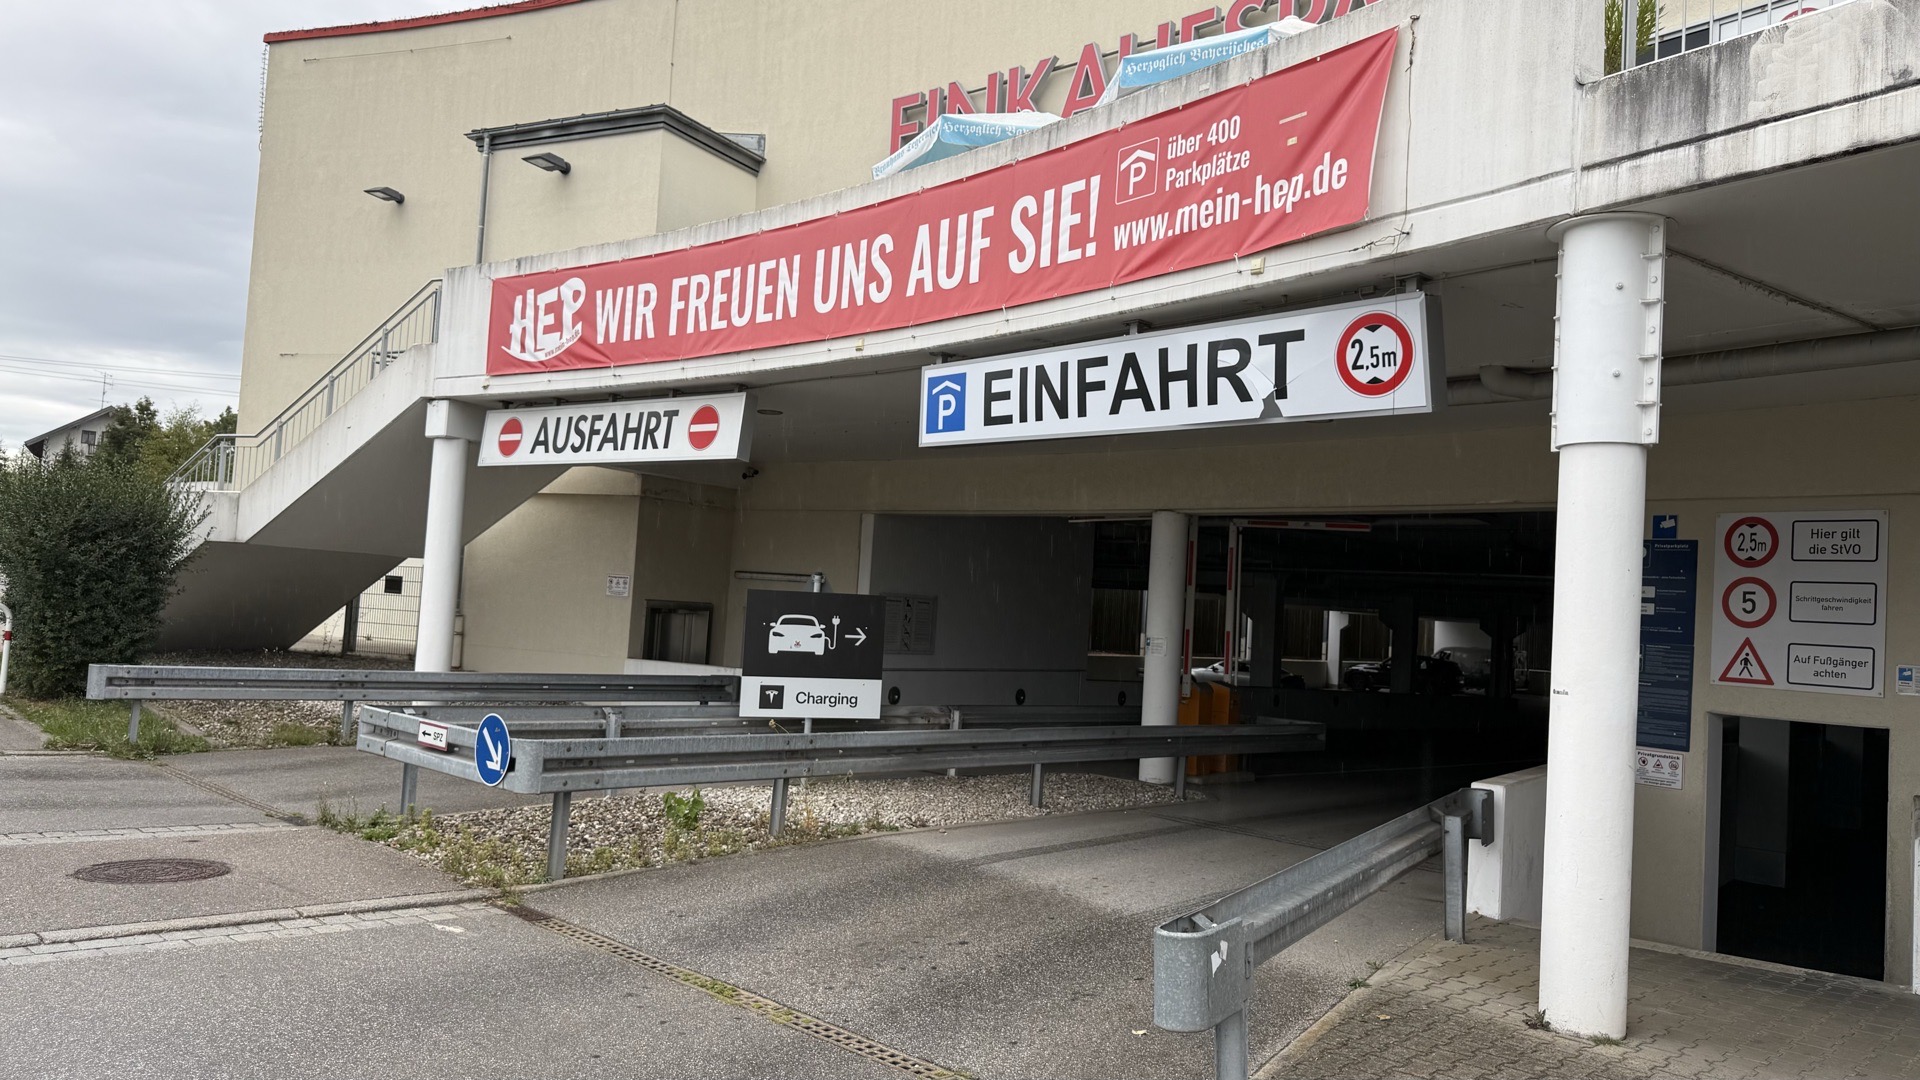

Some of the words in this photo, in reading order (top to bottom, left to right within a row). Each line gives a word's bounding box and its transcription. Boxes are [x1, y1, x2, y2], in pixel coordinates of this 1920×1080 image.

[1125, 53, 1187, 75] Herzoglich
[942, 121, 1001, 138] Herzoglich
[1167, 132, 1203, 160] über
[1207, 115, 1241, 147] 400
[1165, 150, 1250, 191] Parkplätze
[1113, 151, 1349, 251] www.mein-hep.de
[595, 282, 658, 345] WIR
[668, 254, 801, 337] FREUEN
[813, 233, 894, 314] UNS
[905, 206, 996, 297] AUF
[1008, 175, 1102, 274] SIE!
[509, 277, 587, 356] HEP
[1350, 338, 1397, 372] 2,5m
[983, 329, 1305, 427] EINFAHRT
[530, 409, 679, 455] AUSFAHRT
[1737, 532, 1767, 553] 2,5m
[1810, 528, 1837, 540] Hier
[1841, 528, 1861, 543] gilt
[1808, 544, 1828, 555] die
[1831, 544, 1862, 555] StVO
[1741, 591, 1757, 614] 5
[1795, 595, 1872, 605] Schrittgeschwindigkeit
[1821, 604, 1844, 612] fahren
[1793, 655, 1812, 665] Auf
[1813, 655, 1869, 669] Fußgänger
[1813, 668, 1847, 679] achten
[795, 691, 858, 708] Charging
[433, 731, 444, 742] SPZ
